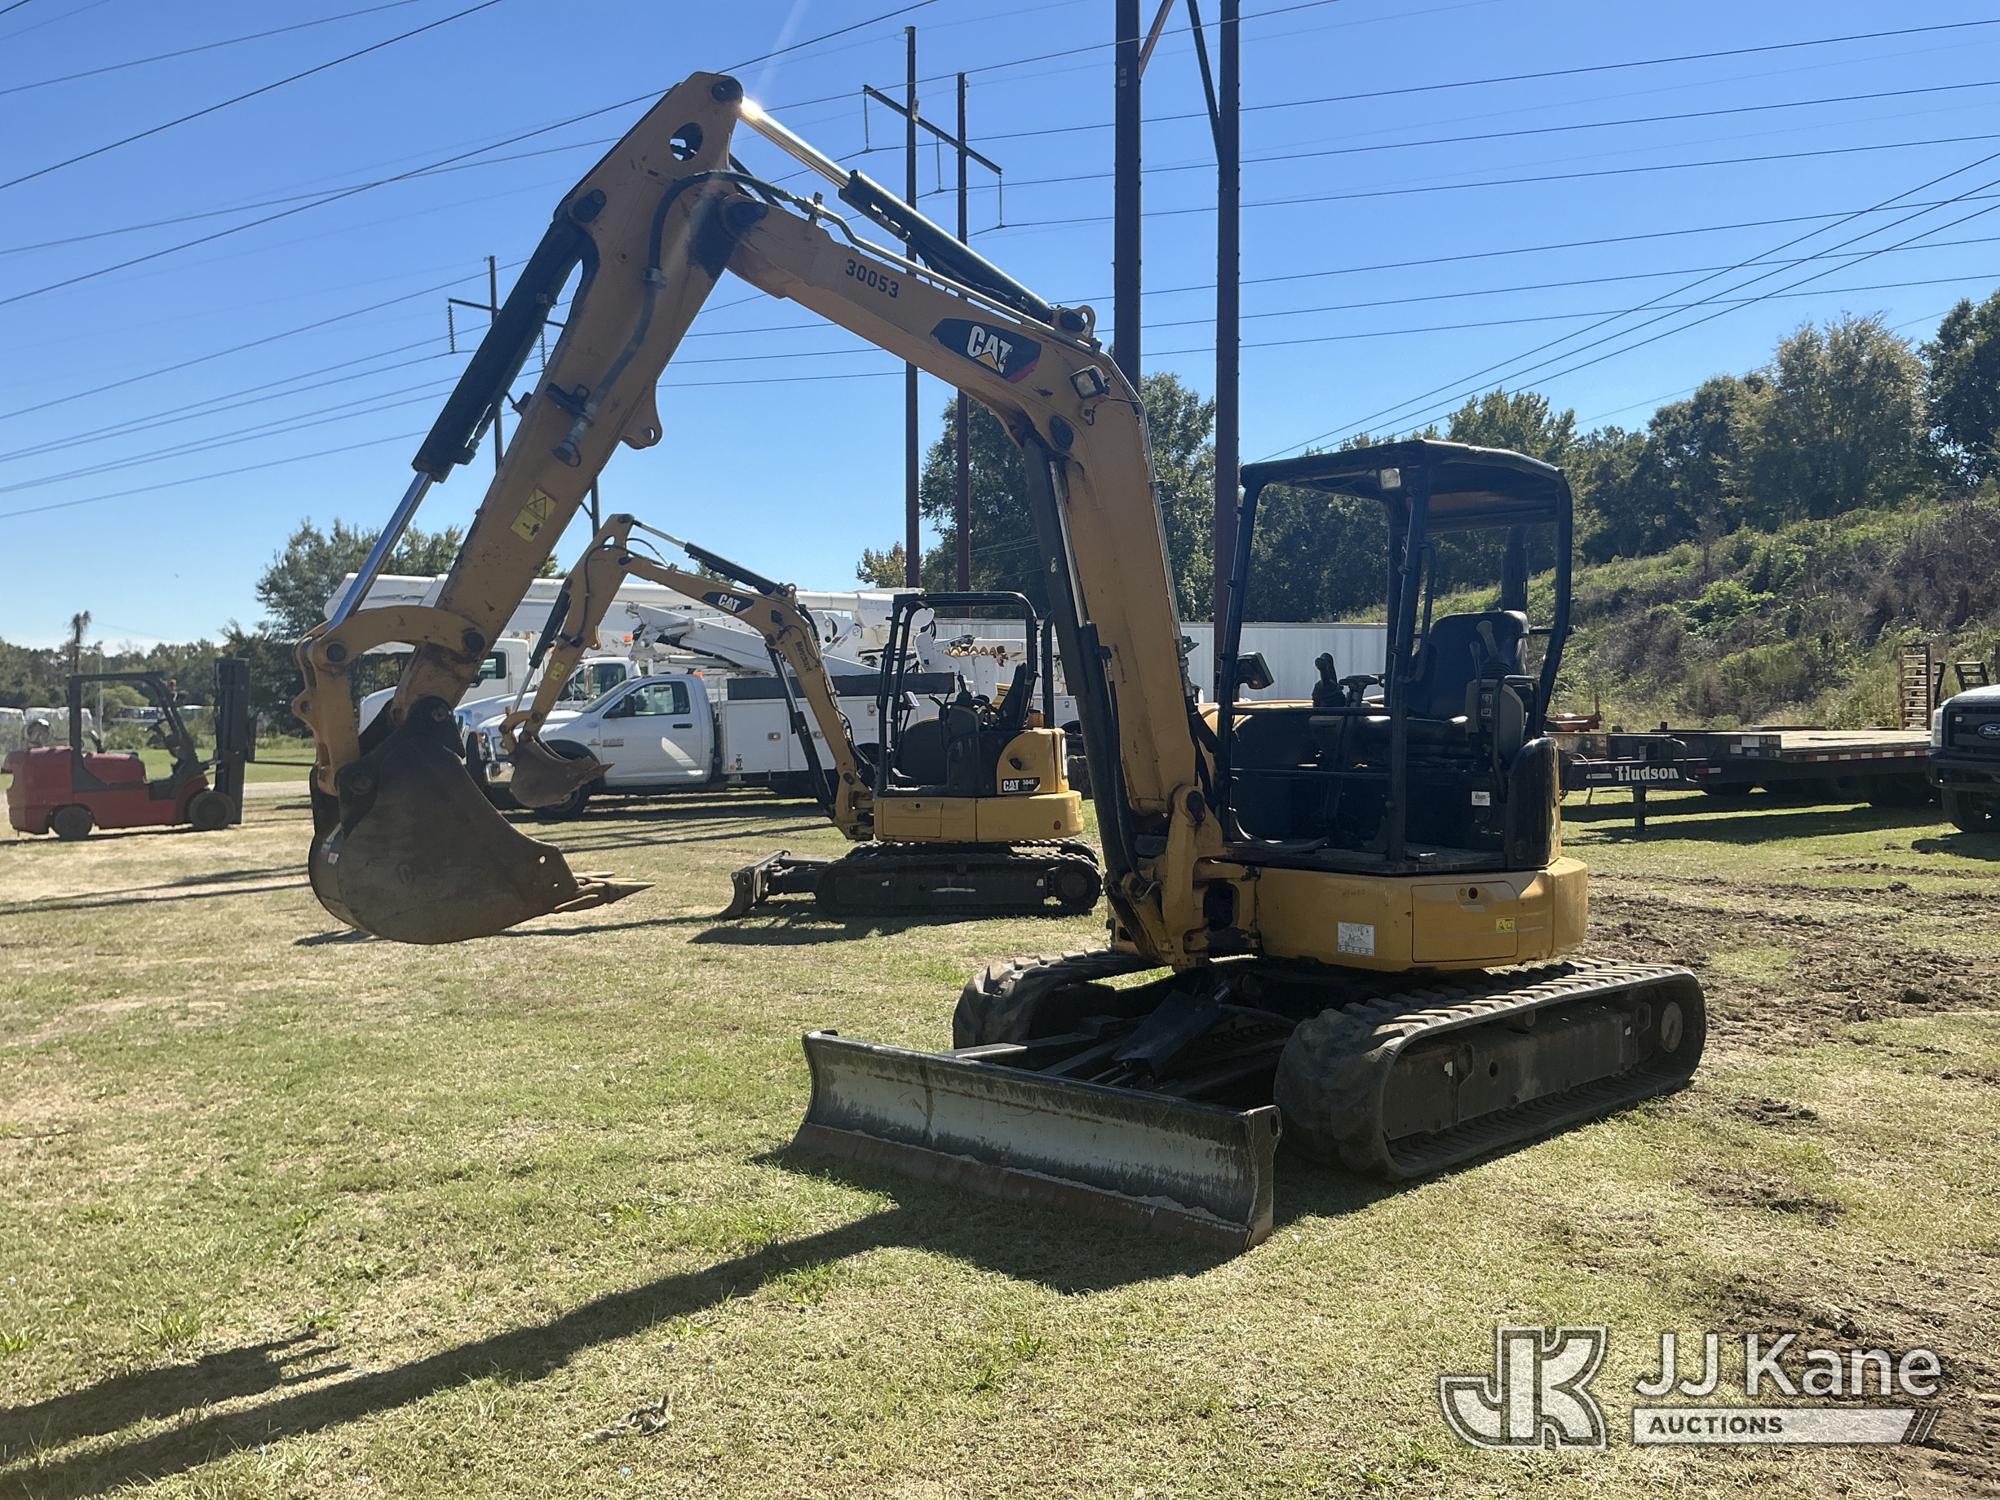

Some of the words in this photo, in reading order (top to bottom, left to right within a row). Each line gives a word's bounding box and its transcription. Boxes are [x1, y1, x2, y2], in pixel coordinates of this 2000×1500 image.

[845, 259, 899, 298] 30053
[967, 325, 1013, 373] CAT
[718, 594, 741, 611] CAT
[1615, 765, 1679, 781] Hudson
[1003, 780, 1020, 791] CAT
